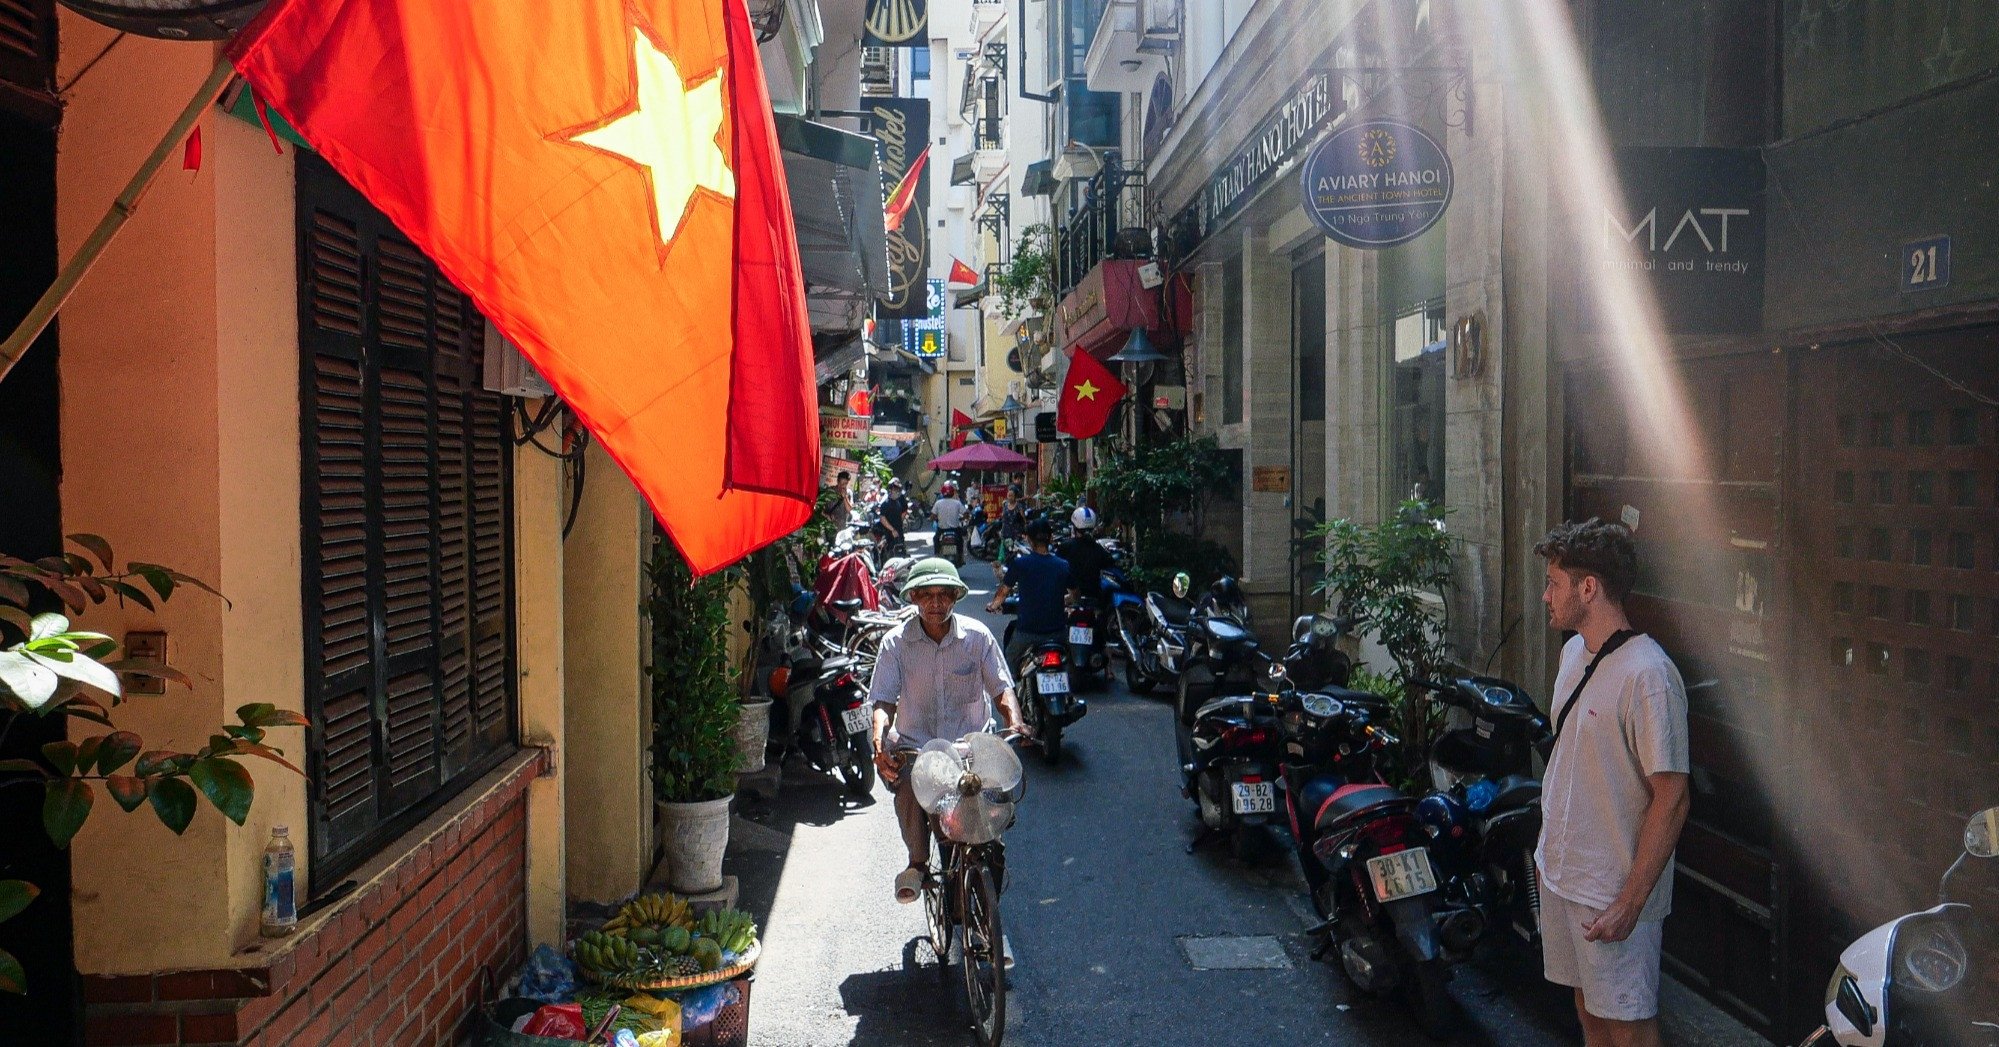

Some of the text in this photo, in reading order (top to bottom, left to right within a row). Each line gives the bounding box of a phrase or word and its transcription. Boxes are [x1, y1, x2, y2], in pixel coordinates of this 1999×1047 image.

[1212, 74, 1331, 219] AVIARY HANOI HOTEL
[1318, 169, 1441, 191] AVIARY HANOI
[1318, 188, 1444, 203] THE ANCIENT TOWN HOTEL
[1603, 206, 1750, 252] MAT
[1668, 259, 1694, 271] and
[1706, 260, 1749, 274] trendy
[1910, 246, 1937, 284] 21
[825, 430, 858, 439] HOTEL
